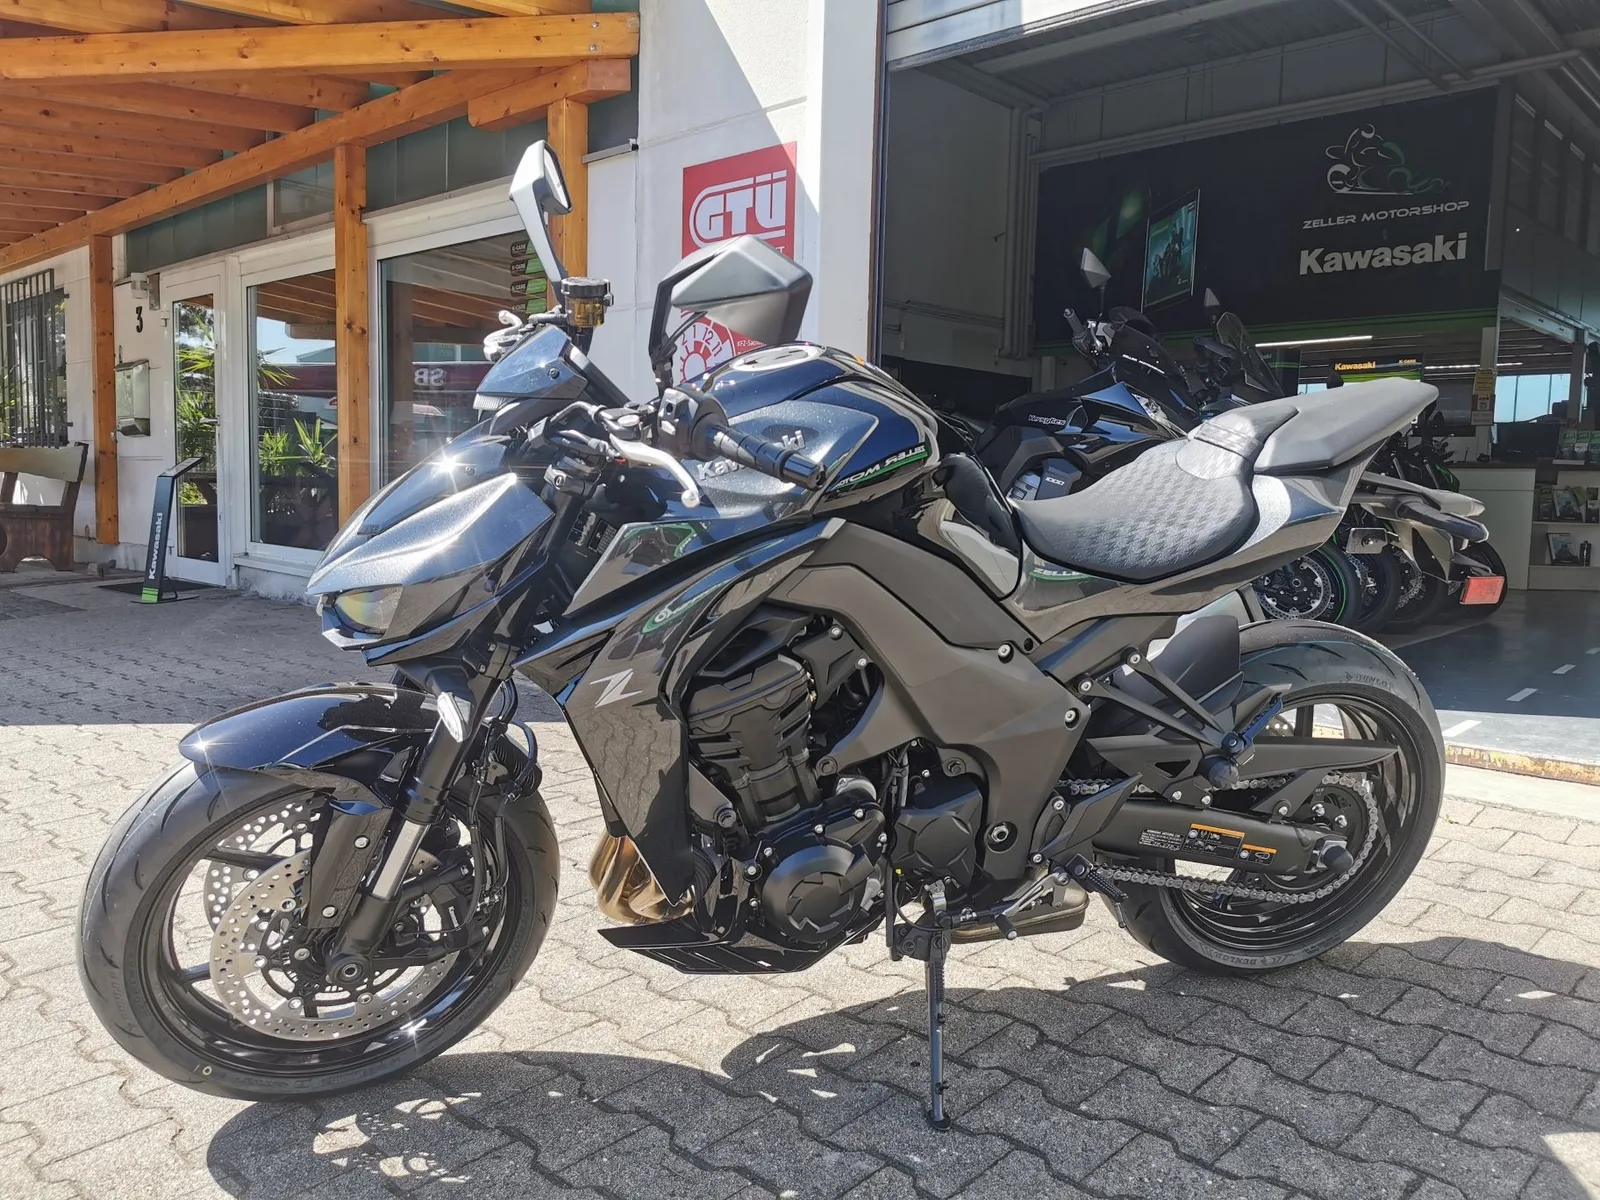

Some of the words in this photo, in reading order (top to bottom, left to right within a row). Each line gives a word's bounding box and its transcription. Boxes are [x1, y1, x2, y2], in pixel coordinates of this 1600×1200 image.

[689, 169, 788, 248] GTÜ
[1303, 214, 1356, 229] ZELLER
[1361, 200, 1470, 222] MOTORSHOP
[1299, 232, 1468, 275] Kawasaki
[135, 305, 143, 333] 3
[703, 327, 714, 345] 12
[1335, 361, 1376, 371] Kawasaki
[148, 512, 163, 580] Kawasaki
